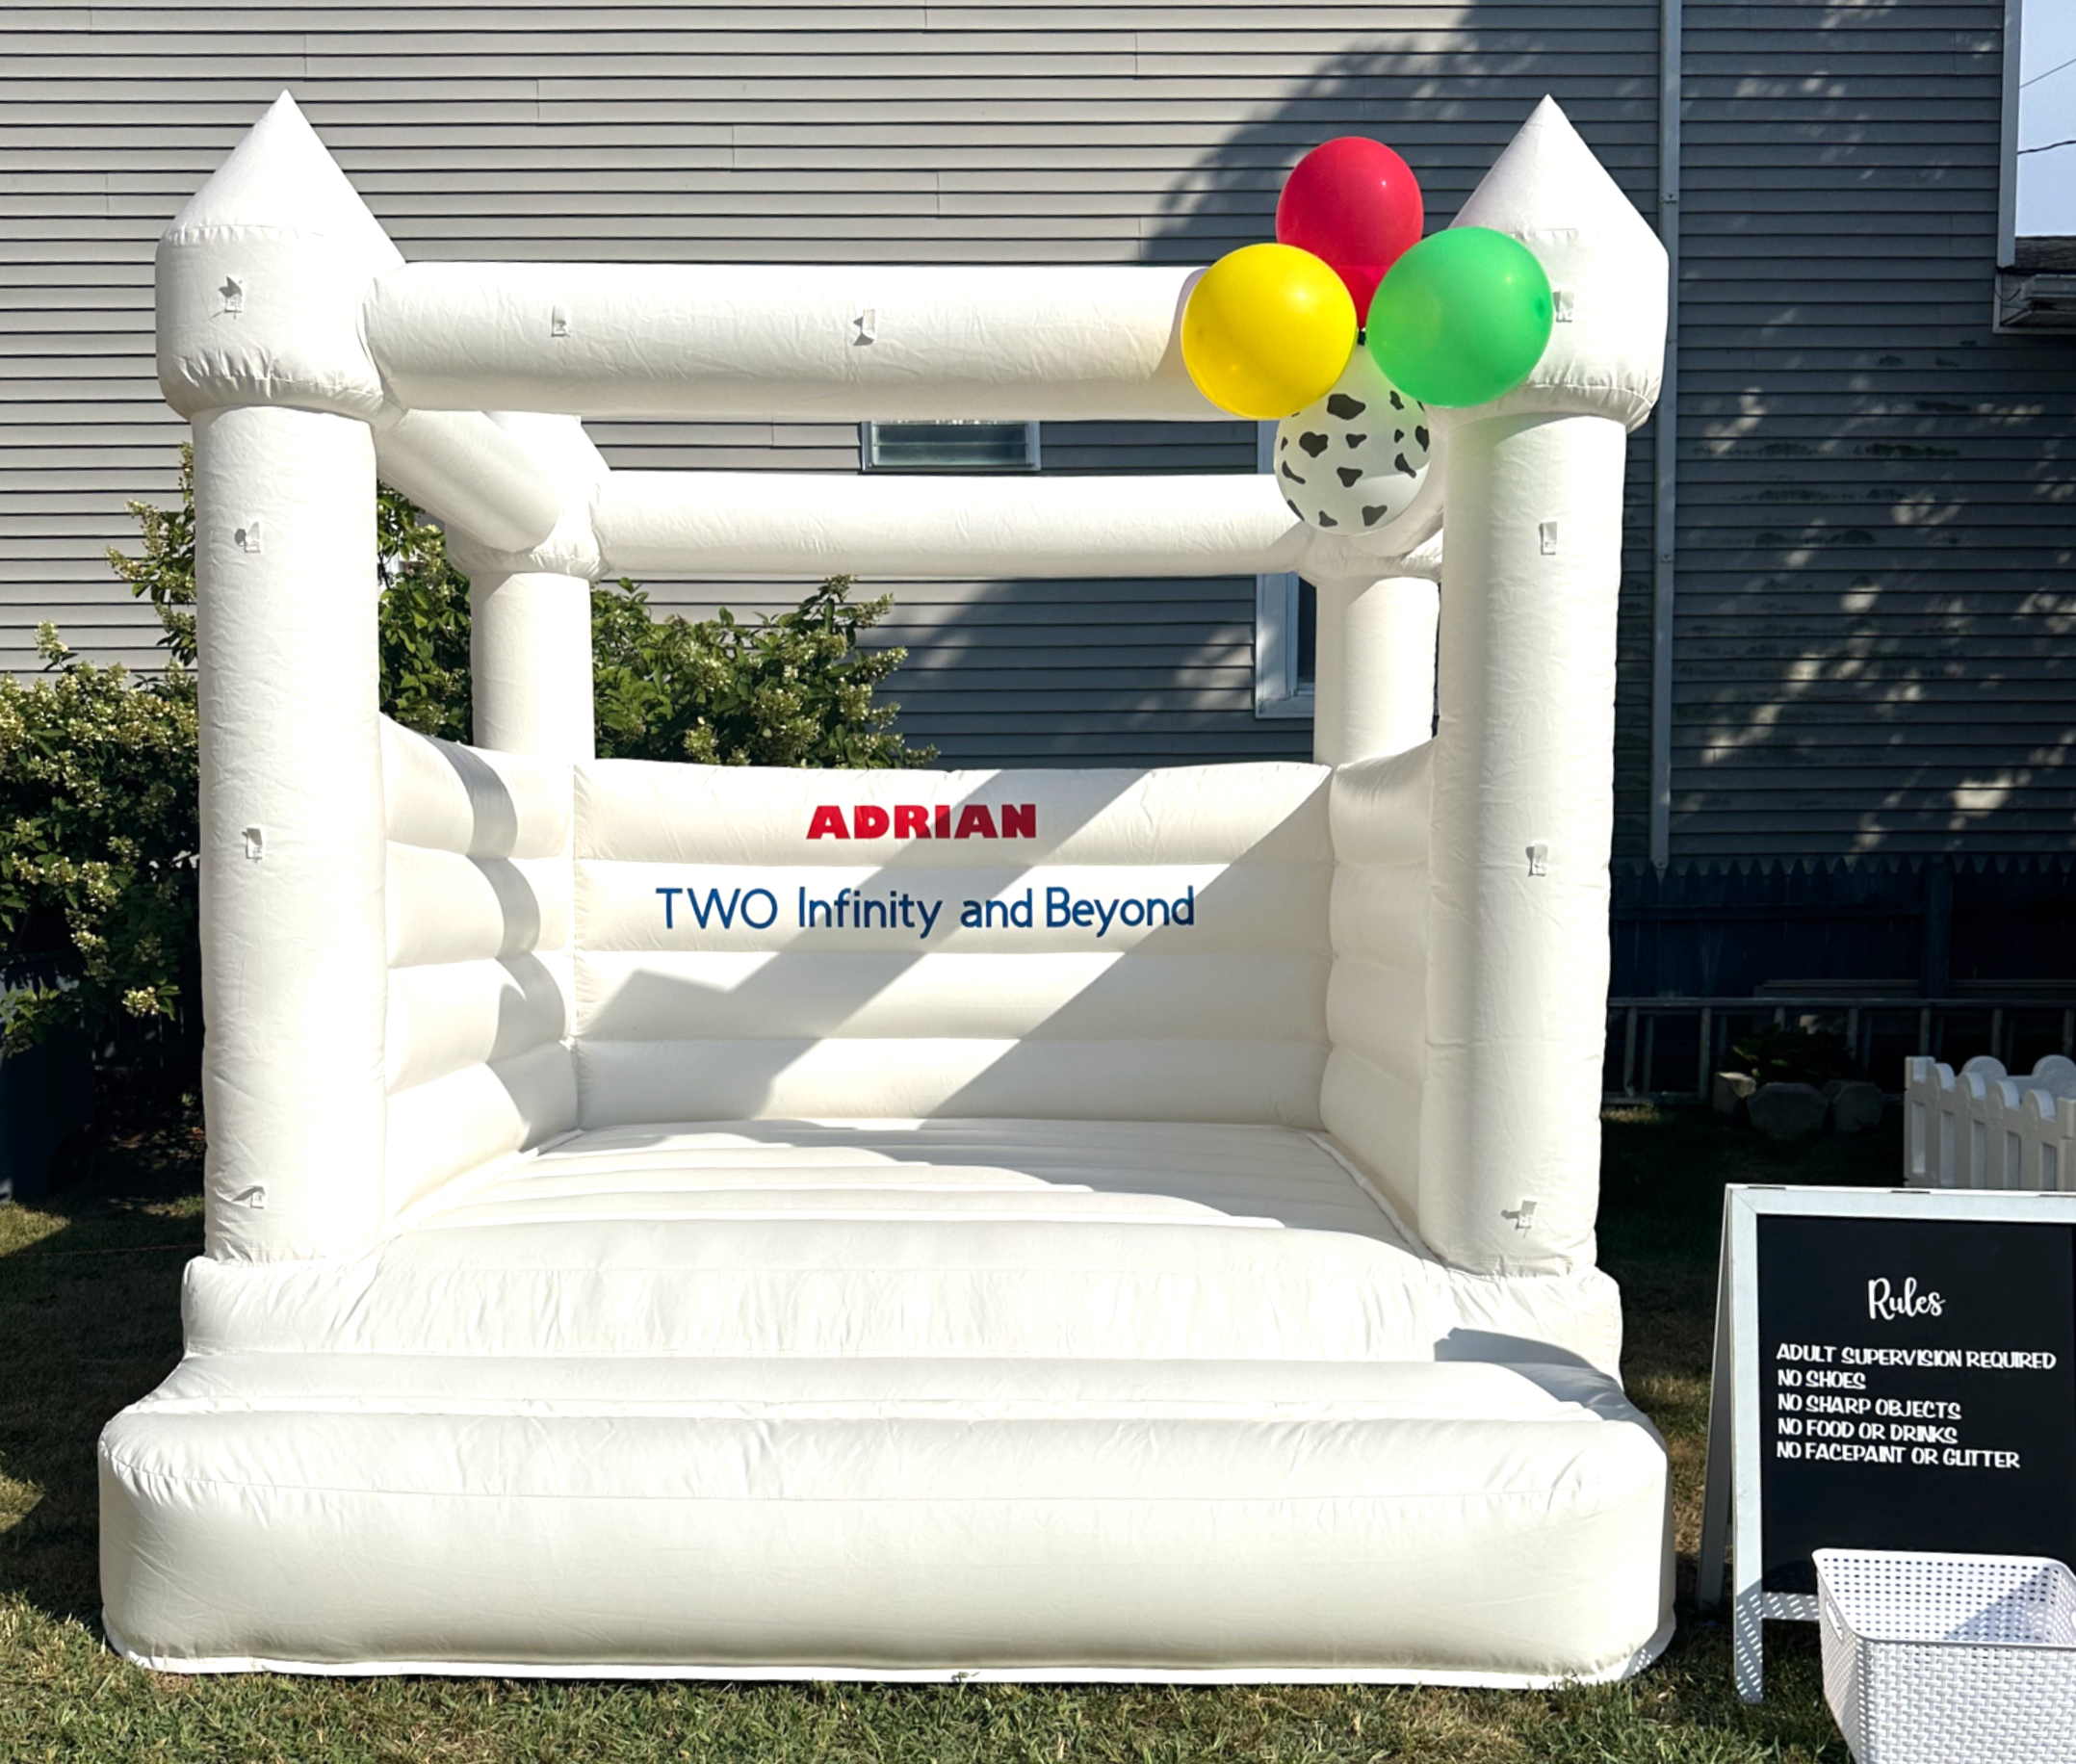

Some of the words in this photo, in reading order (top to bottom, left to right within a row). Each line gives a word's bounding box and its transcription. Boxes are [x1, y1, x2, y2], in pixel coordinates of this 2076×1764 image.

[807, 805, 1035, 840] ADRIAN
[657, 889, 777, 928] TWO
[799, 887, 943, 938] Infinity
[961, 888, 1033, 928] and
[1047, 887, 1193, 936] Beyond
[1869, 1277, 1945, 1320] Rules
[1777, 1343, 1836, 1362] ADULT
[1841, 1347, 1961, 1367] SUPERVISION
[1966, 1351, 2056, 1369] REQUIRED
[1778, 1369, 1802, 1387] NO
[1805, 1370, 1866, 1389] SHOES
[1778, 1393, 1803, 1411] NO
[1805, 1395, 1871, 1414] SHARP
[1876, 1399, 1961, 1419] OBJECTS
[1778, 1417, 1803, 1435] NO
[1806, 1419, 1855, 1438] FOOD
[1858, 1422, 1885, 1440] OR
[1890, 1424, 1958, 1444] DRINKS
[1777, 1441, 1802, 1458] NO
[1805, 1442, 1907, 1463] FACEPAINT
[1911, 1447, 1938, 1465] OR
[1943, 1448, 2020, 1467] GLITTER
